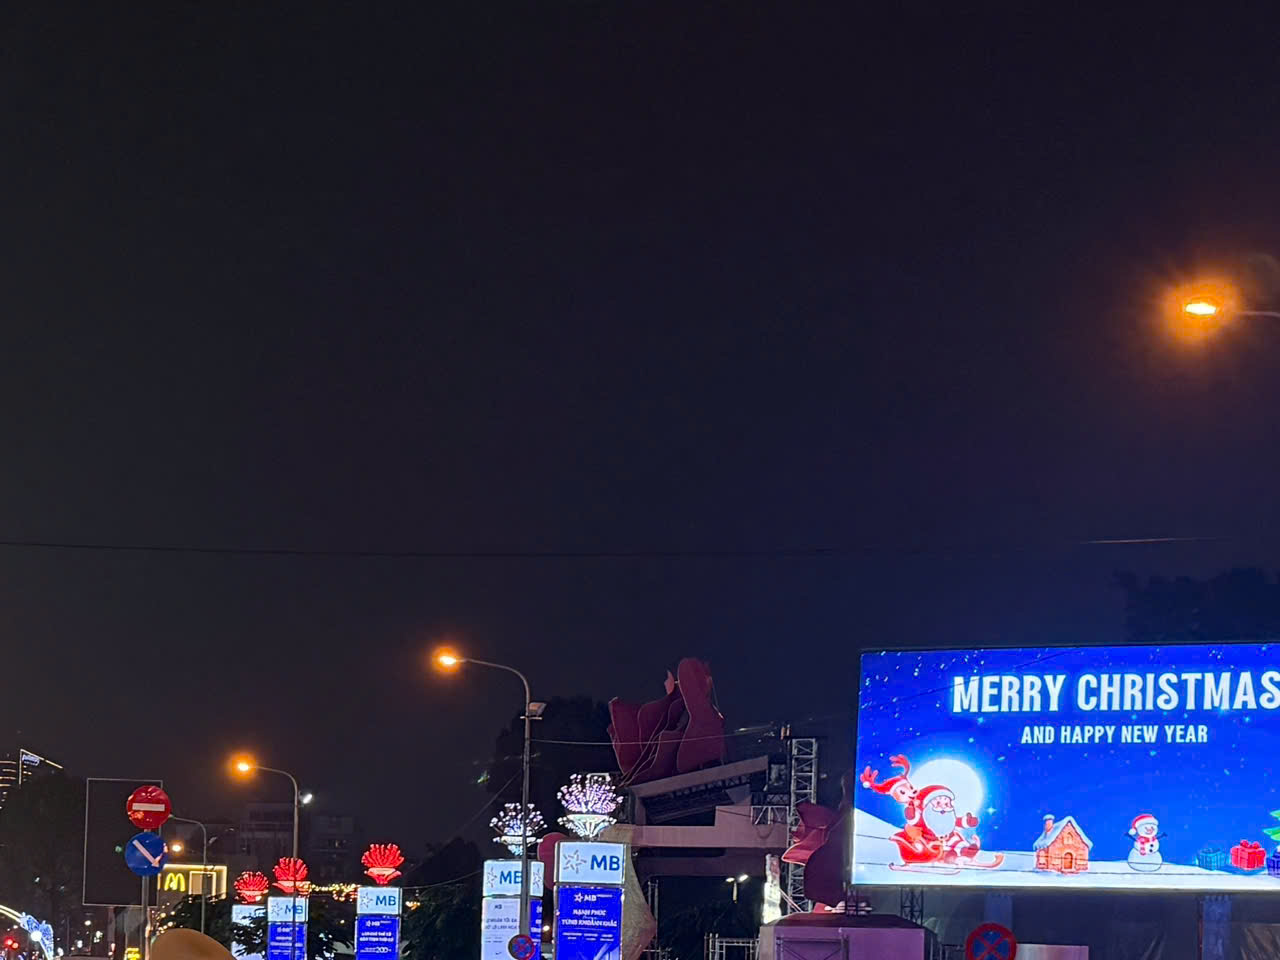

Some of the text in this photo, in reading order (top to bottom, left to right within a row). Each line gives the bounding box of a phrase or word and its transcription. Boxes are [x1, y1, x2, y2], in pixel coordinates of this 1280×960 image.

[953, 671, 1280, 713] MERRY CHRISTMAS
[1021, 724, 1209, 744] AND HAPPY NEW YEAR
[590, 854, 621, 871] MB
[375, 895, 397, 906] MB
